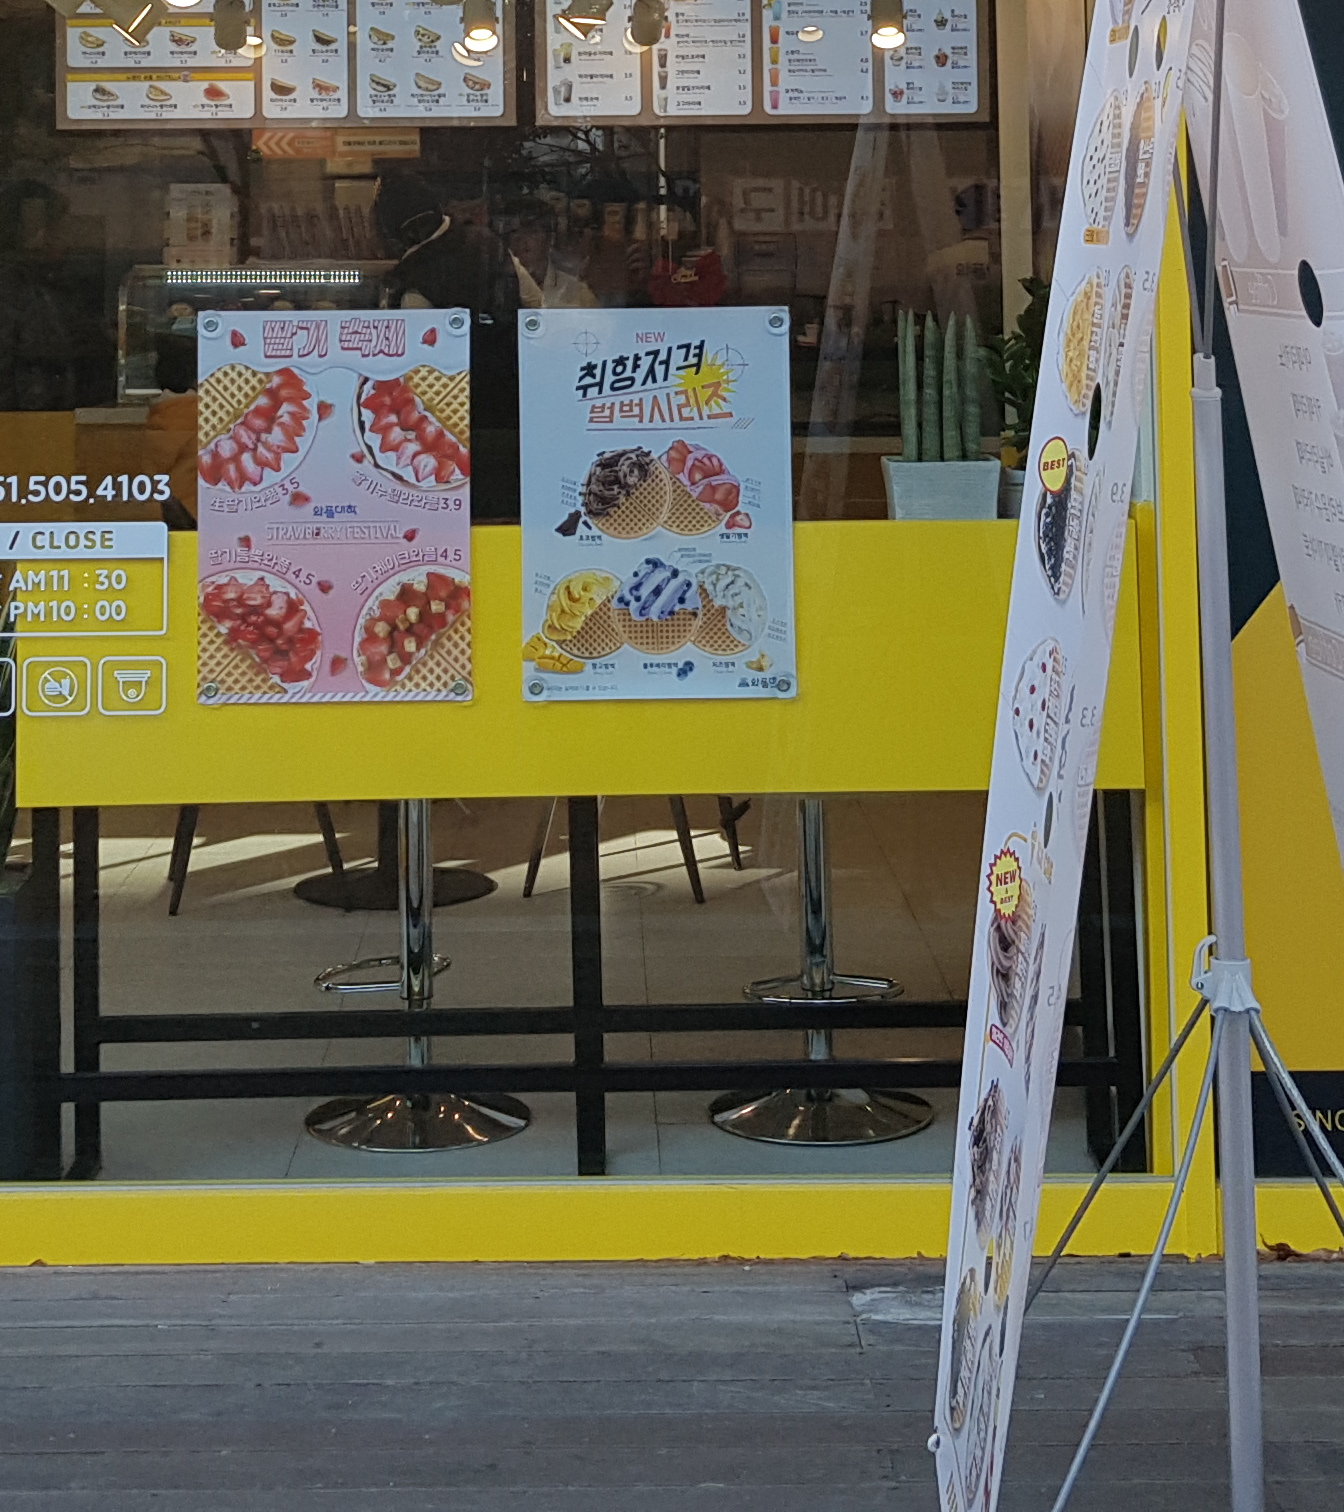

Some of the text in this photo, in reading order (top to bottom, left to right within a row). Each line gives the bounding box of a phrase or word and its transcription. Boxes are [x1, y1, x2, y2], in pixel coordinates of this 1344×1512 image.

[263, 318, 406, 358] 딸기 축제
[635, 331, 666, 344] NEW
[575, 340, 706, 399] 취향저격
[588, 382, 734, 425] 범벅시리즈
[1042, 457, 1066, 472] BEST
[278, 476, 301, 496] 3.5
[313, 504, 358, 519] 와플대학
[440, 497, 462, 512] 3.9
[31, 530, 114, 550] CLOSE
[266, 523, 402, 541] STRAWBERRY FESTIVAL
[439, 548, 462, 563] 4.5
[292, 568, 315, 586] 4.5
[995, 869, 1017, 889] NEW
